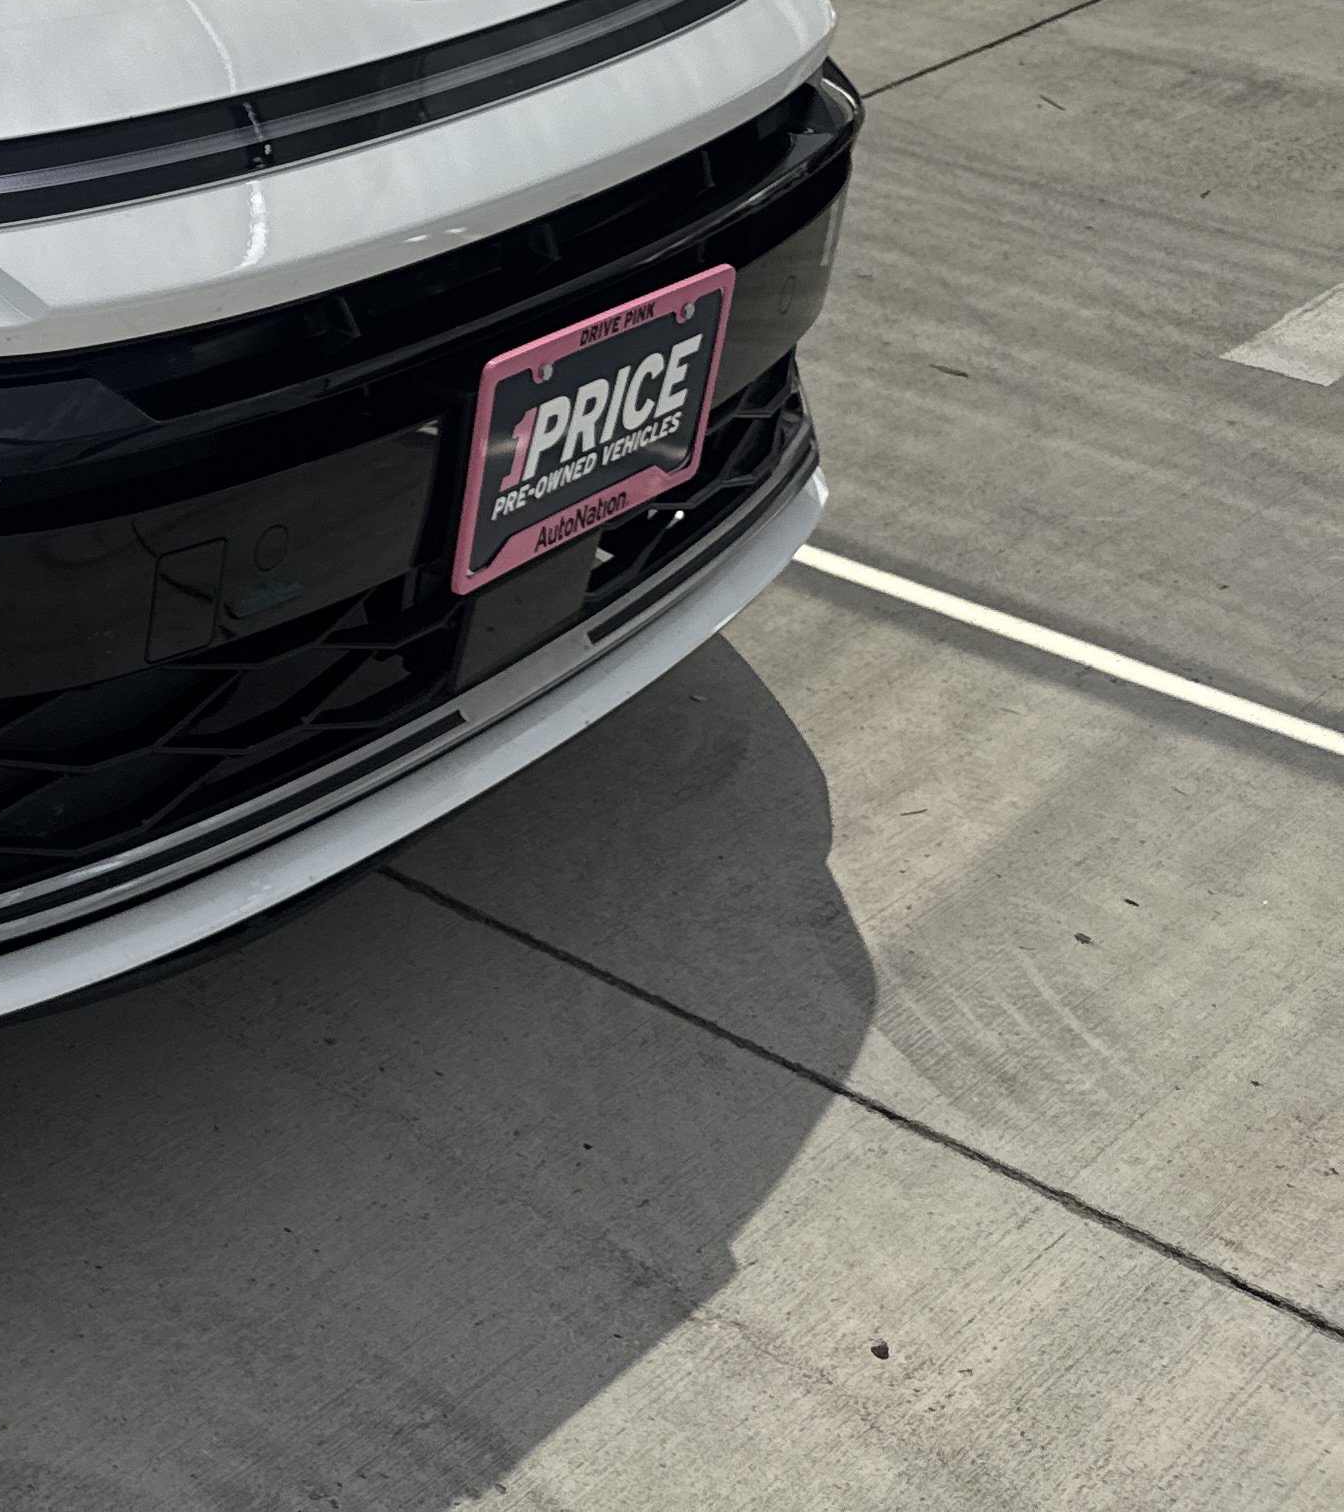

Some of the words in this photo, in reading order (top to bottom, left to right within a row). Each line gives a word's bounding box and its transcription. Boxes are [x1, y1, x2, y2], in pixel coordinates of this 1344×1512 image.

[579, 316, 621, 347] DRIVE
[623, 301, 656, 329] PINK
[490, 452, 599, 521] PRE-OWNED
[601, 411, 682, 466] VEHICLES
[533, 491, 628, 552] AutoNation
